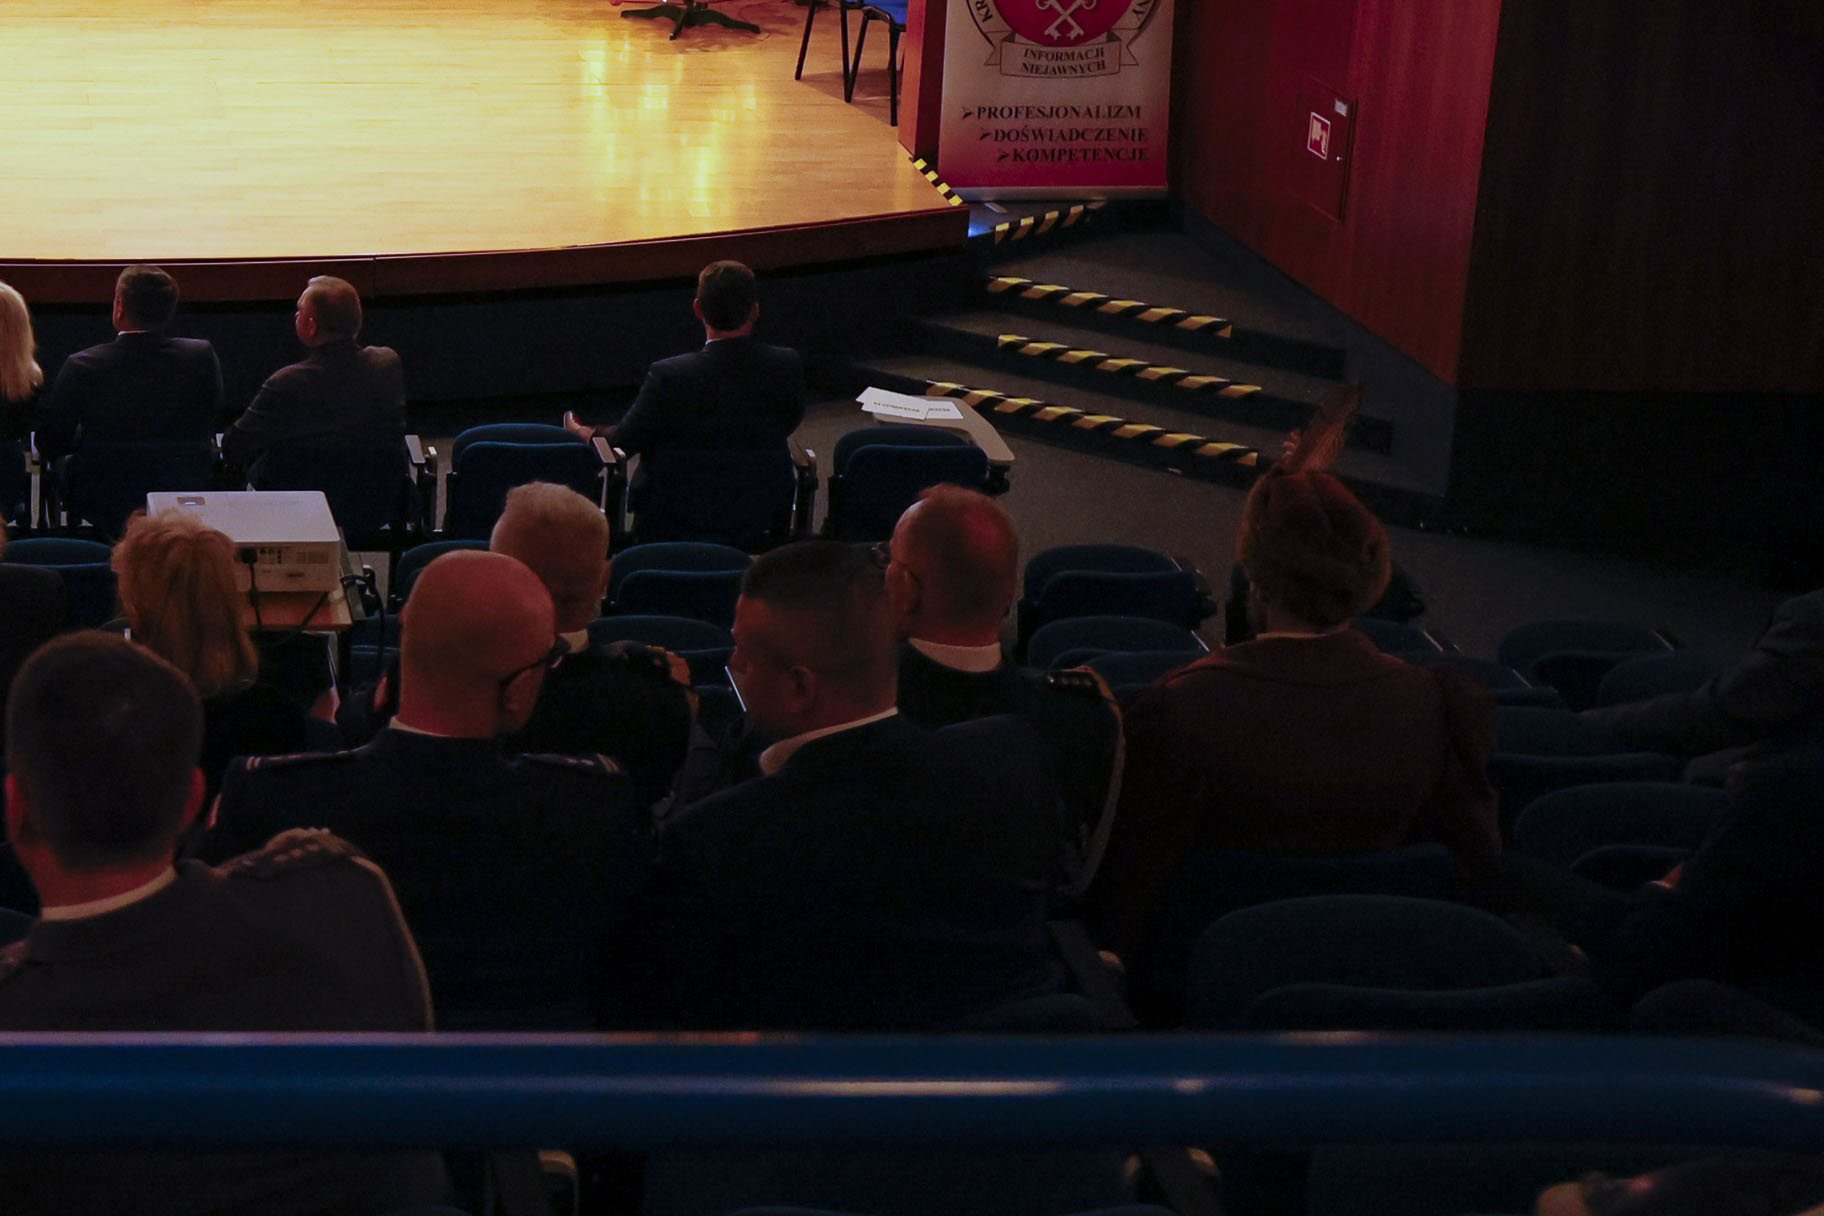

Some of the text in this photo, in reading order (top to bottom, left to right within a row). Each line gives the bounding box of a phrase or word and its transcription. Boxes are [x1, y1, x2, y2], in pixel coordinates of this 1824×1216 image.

[1023, 47, 1105, 63] INFORMACJI
[1021, 59, 1106, 75] NIEJAWNYCH
[977, 105, 1142, 120] PROFESJONALIZM
[994, 125, 1149, 142] DOŚWIADCZENIE
[1012, 147, 1149, 162] KOMPETENCJE
